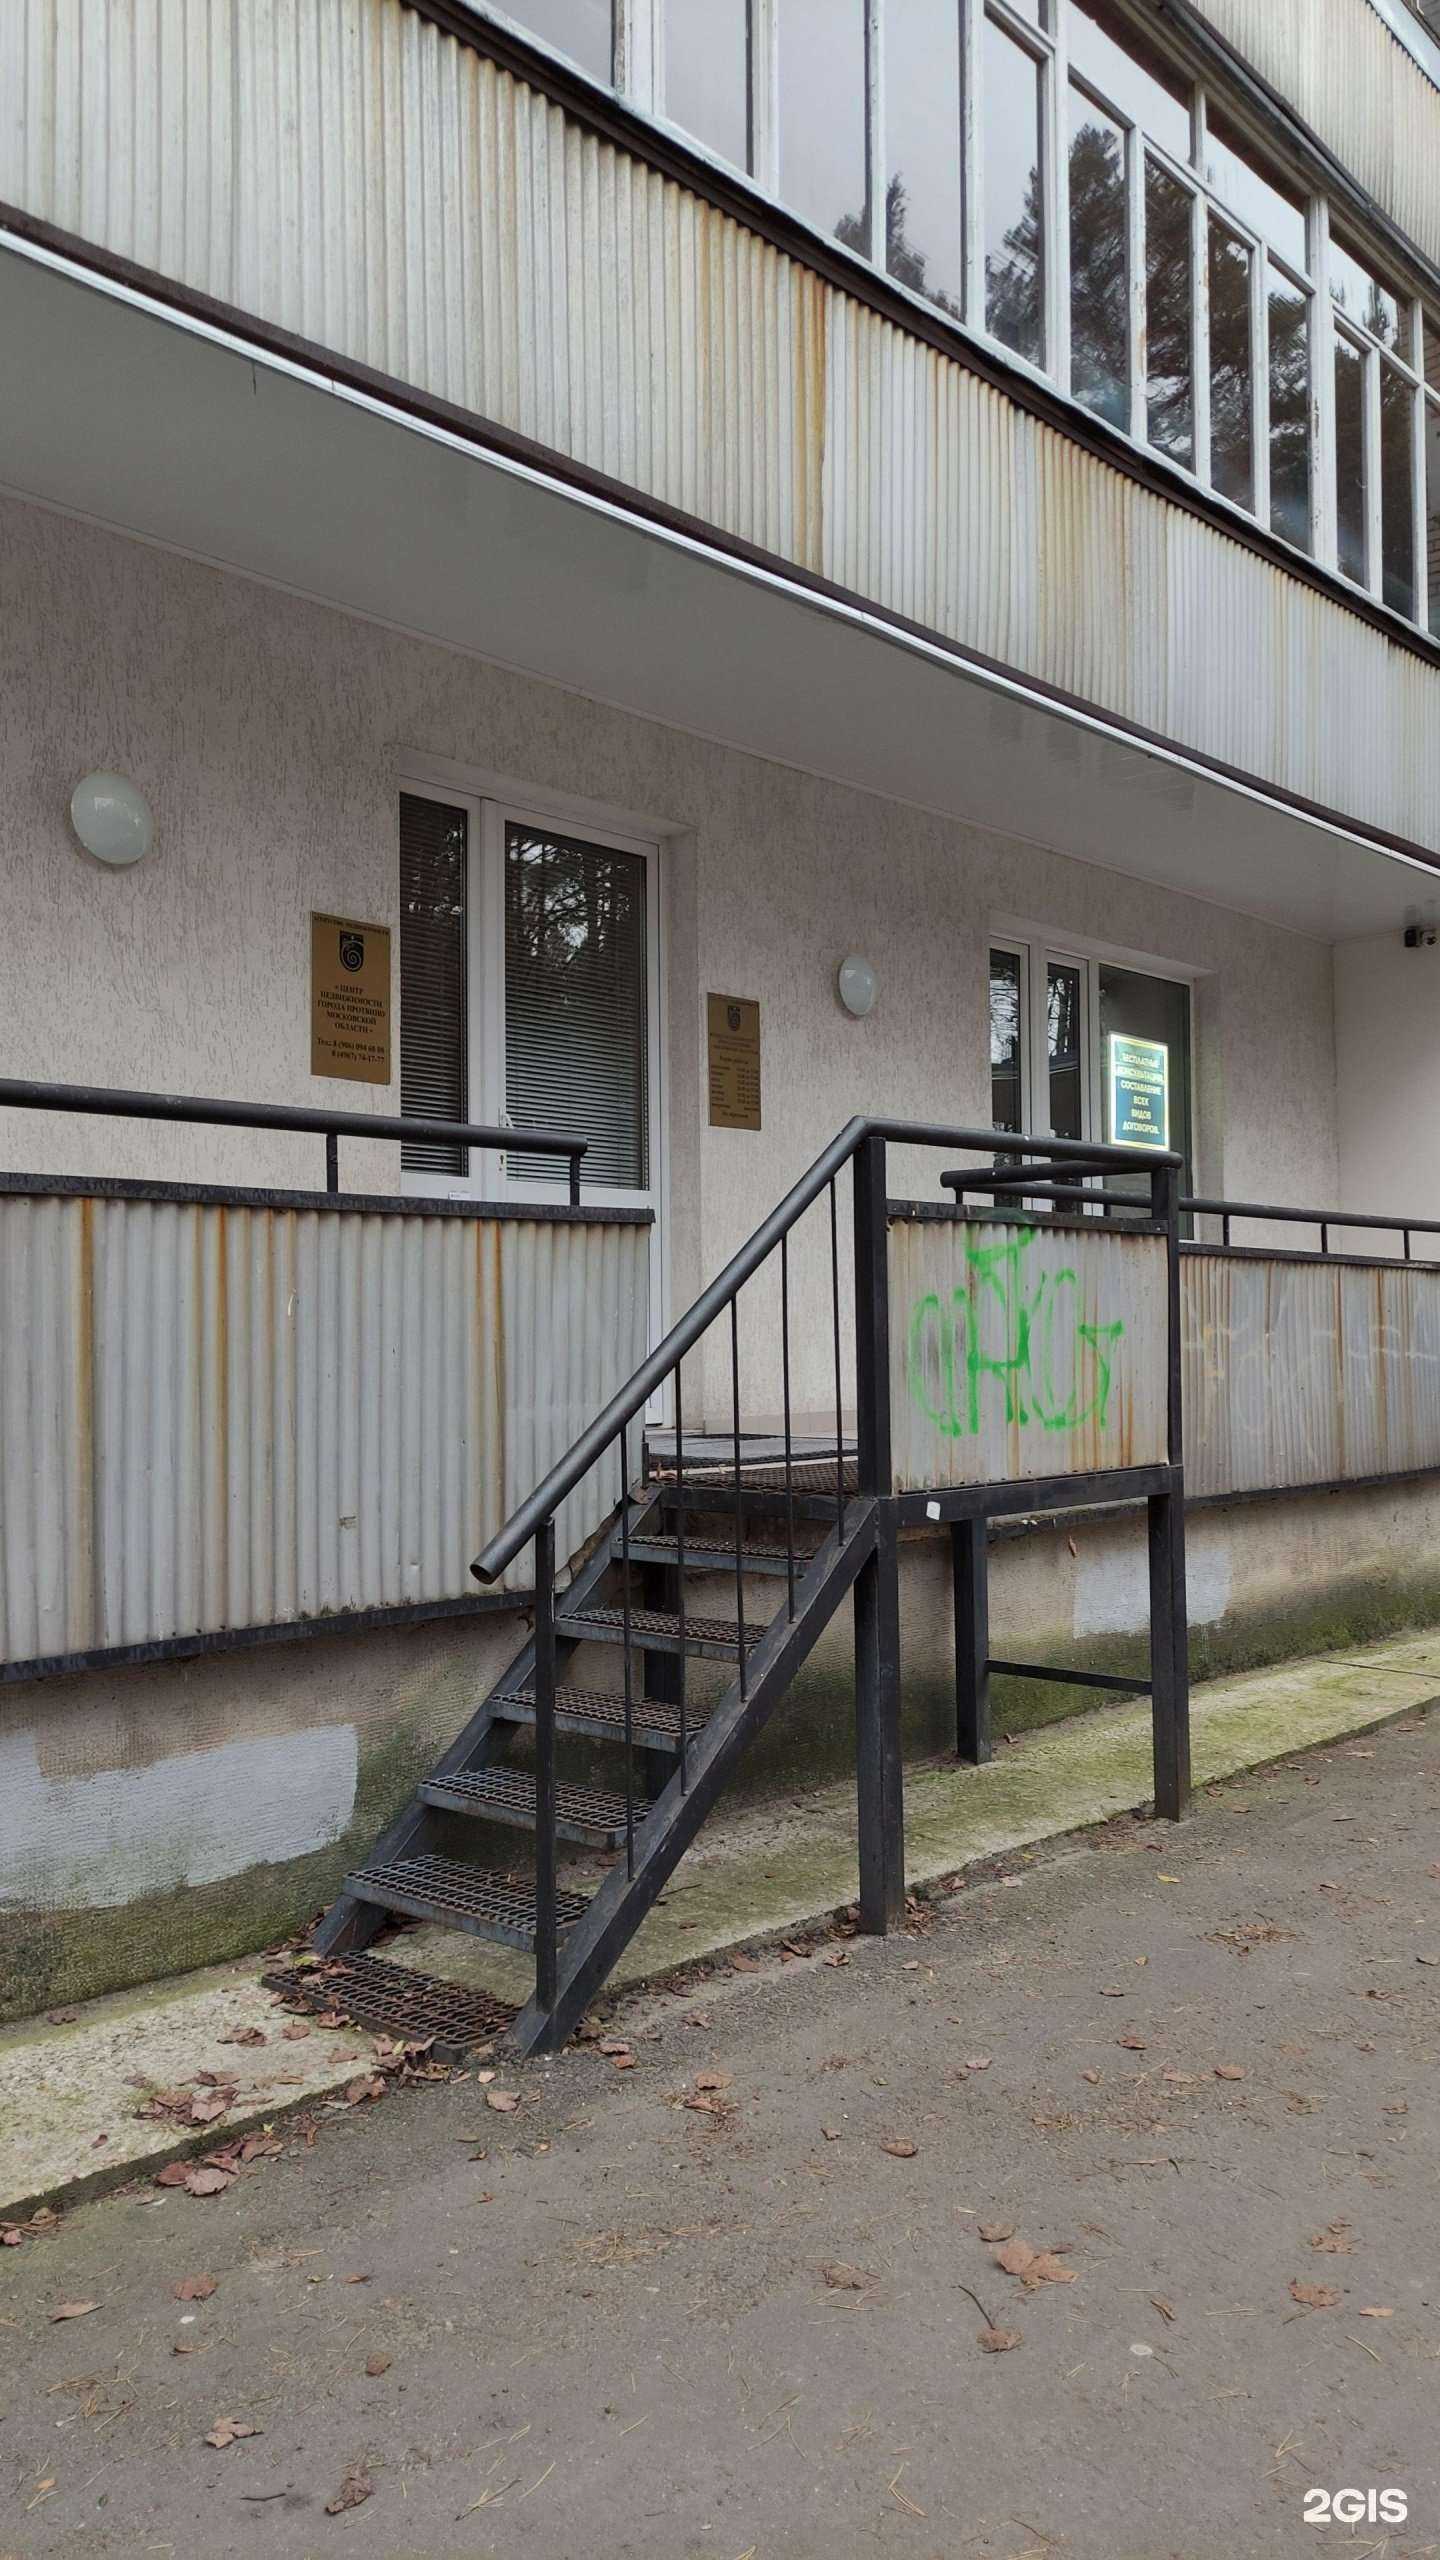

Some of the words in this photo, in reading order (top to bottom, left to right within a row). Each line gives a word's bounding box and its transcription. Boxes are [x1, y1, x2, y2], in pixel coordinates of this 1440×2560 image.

[327, 1010, 376, 1025] МОСКОВСКОЙ
[1133, 1095, 1149, 1106] ВСЕХ
[1131, 1108, 1152, 1120] ВИДОВ
